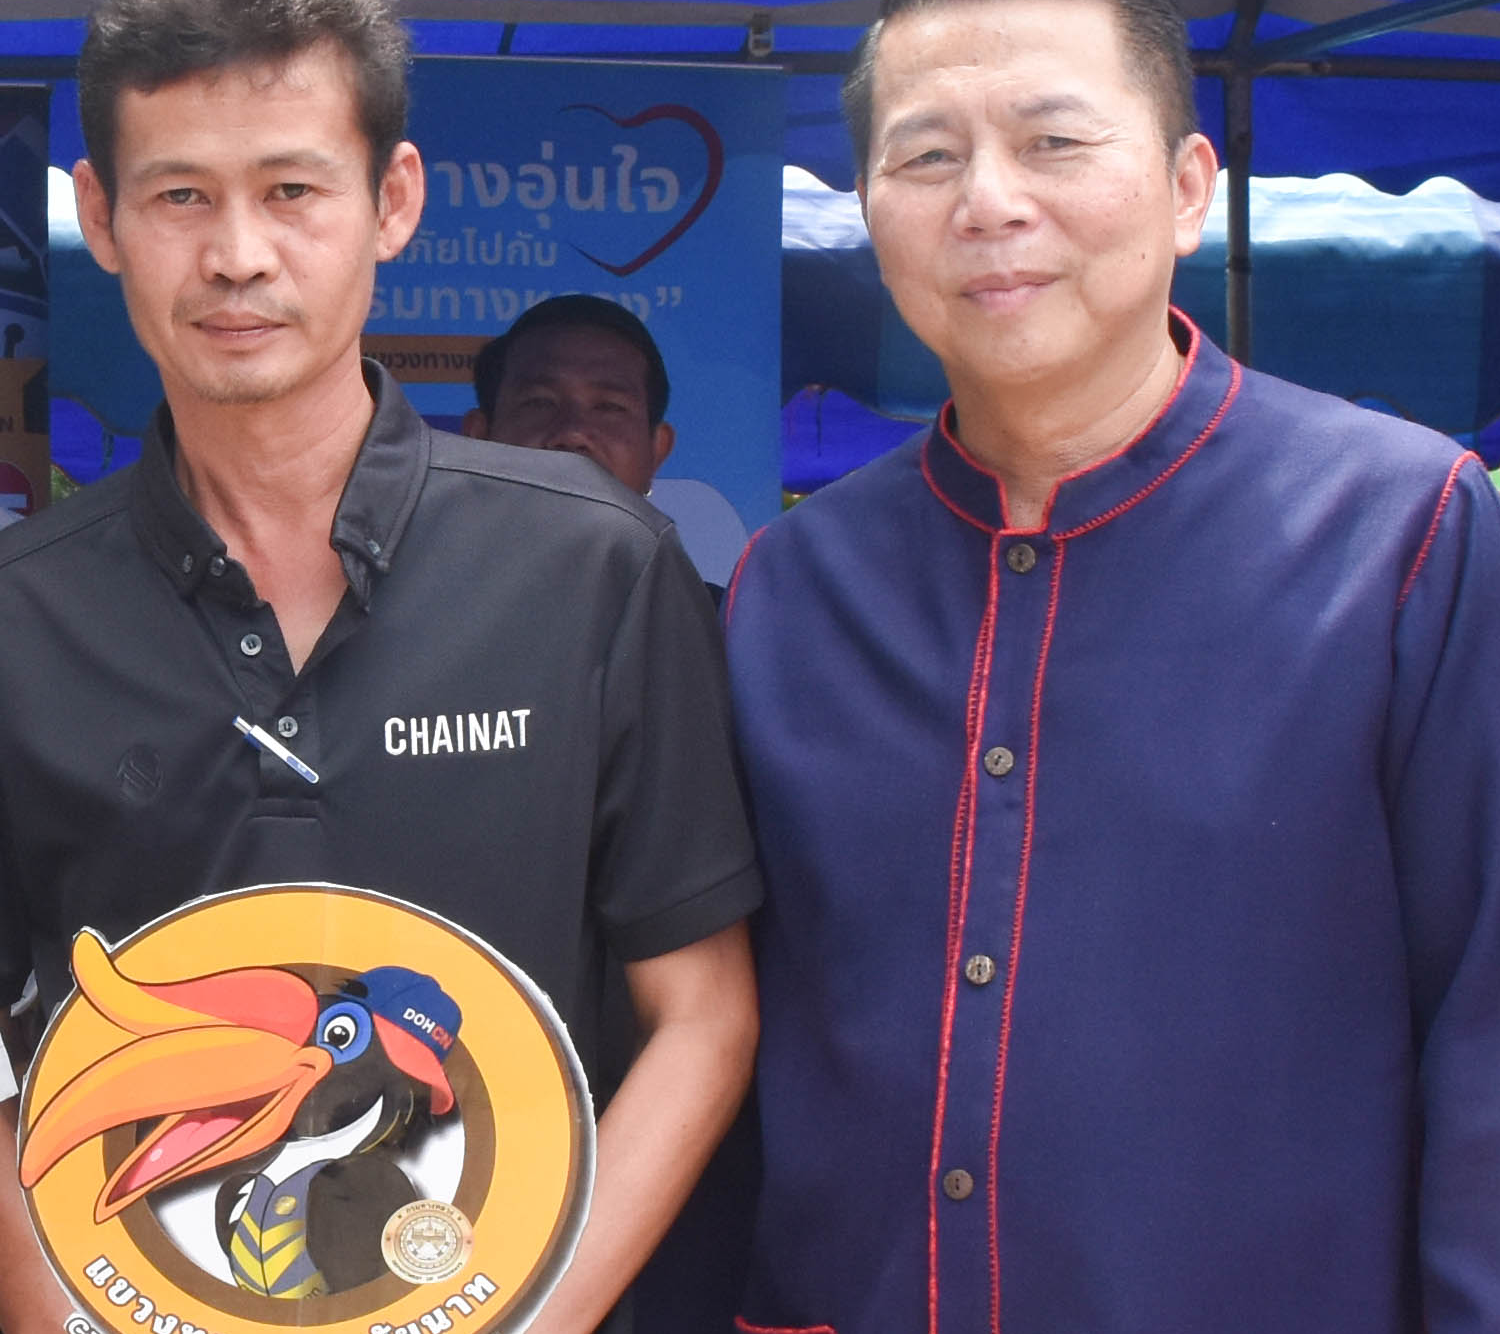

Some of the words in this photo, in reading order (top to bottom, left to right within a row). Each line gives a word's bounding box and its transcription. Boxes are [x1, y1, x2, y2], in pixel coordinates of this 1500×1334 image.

[435, 141, 682, 229] างอุ่นใจ
[383, 709, 532, 756] CHAINAT
